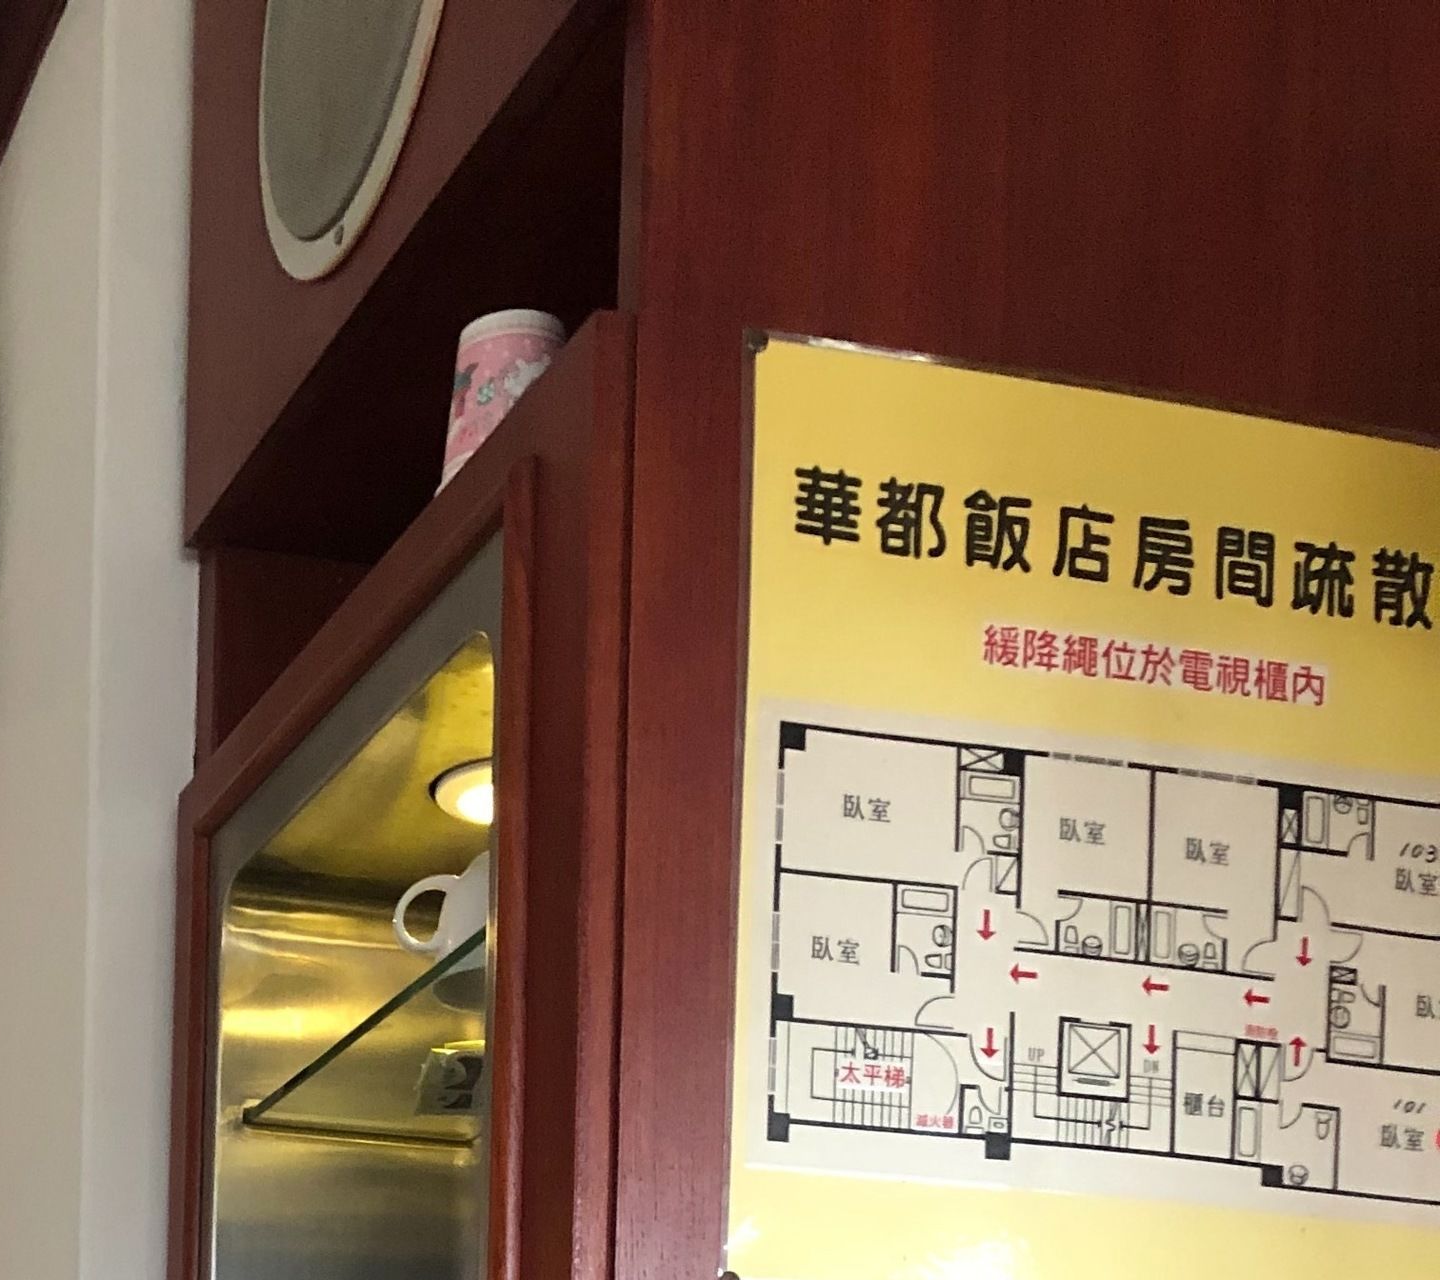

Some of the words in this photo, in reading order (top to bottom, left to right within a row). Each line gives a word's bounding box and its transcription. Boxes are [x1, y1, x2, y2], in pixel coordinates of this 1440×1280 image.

[794, 466, 1436, 629] 華都飯店房間疏散
[982, 624, 1327, 706] 緩降繩位於電視櫃內
[842, 793, 892, 823] 臥室
[1059, 817, 1107, 846] 臥室
[1185, 837, 1231, 867] 臥室
[1399, 842, 1438, 863] 103
[810, 936, 861, 965] 臥室
[1415, 994, 1440, 1020] 臥
[839, 1062, 906, 1090] 太平梯
[1393, 1099, 1427, 1115] 101
[1379, 1124, 1425, 1152] 臥室
